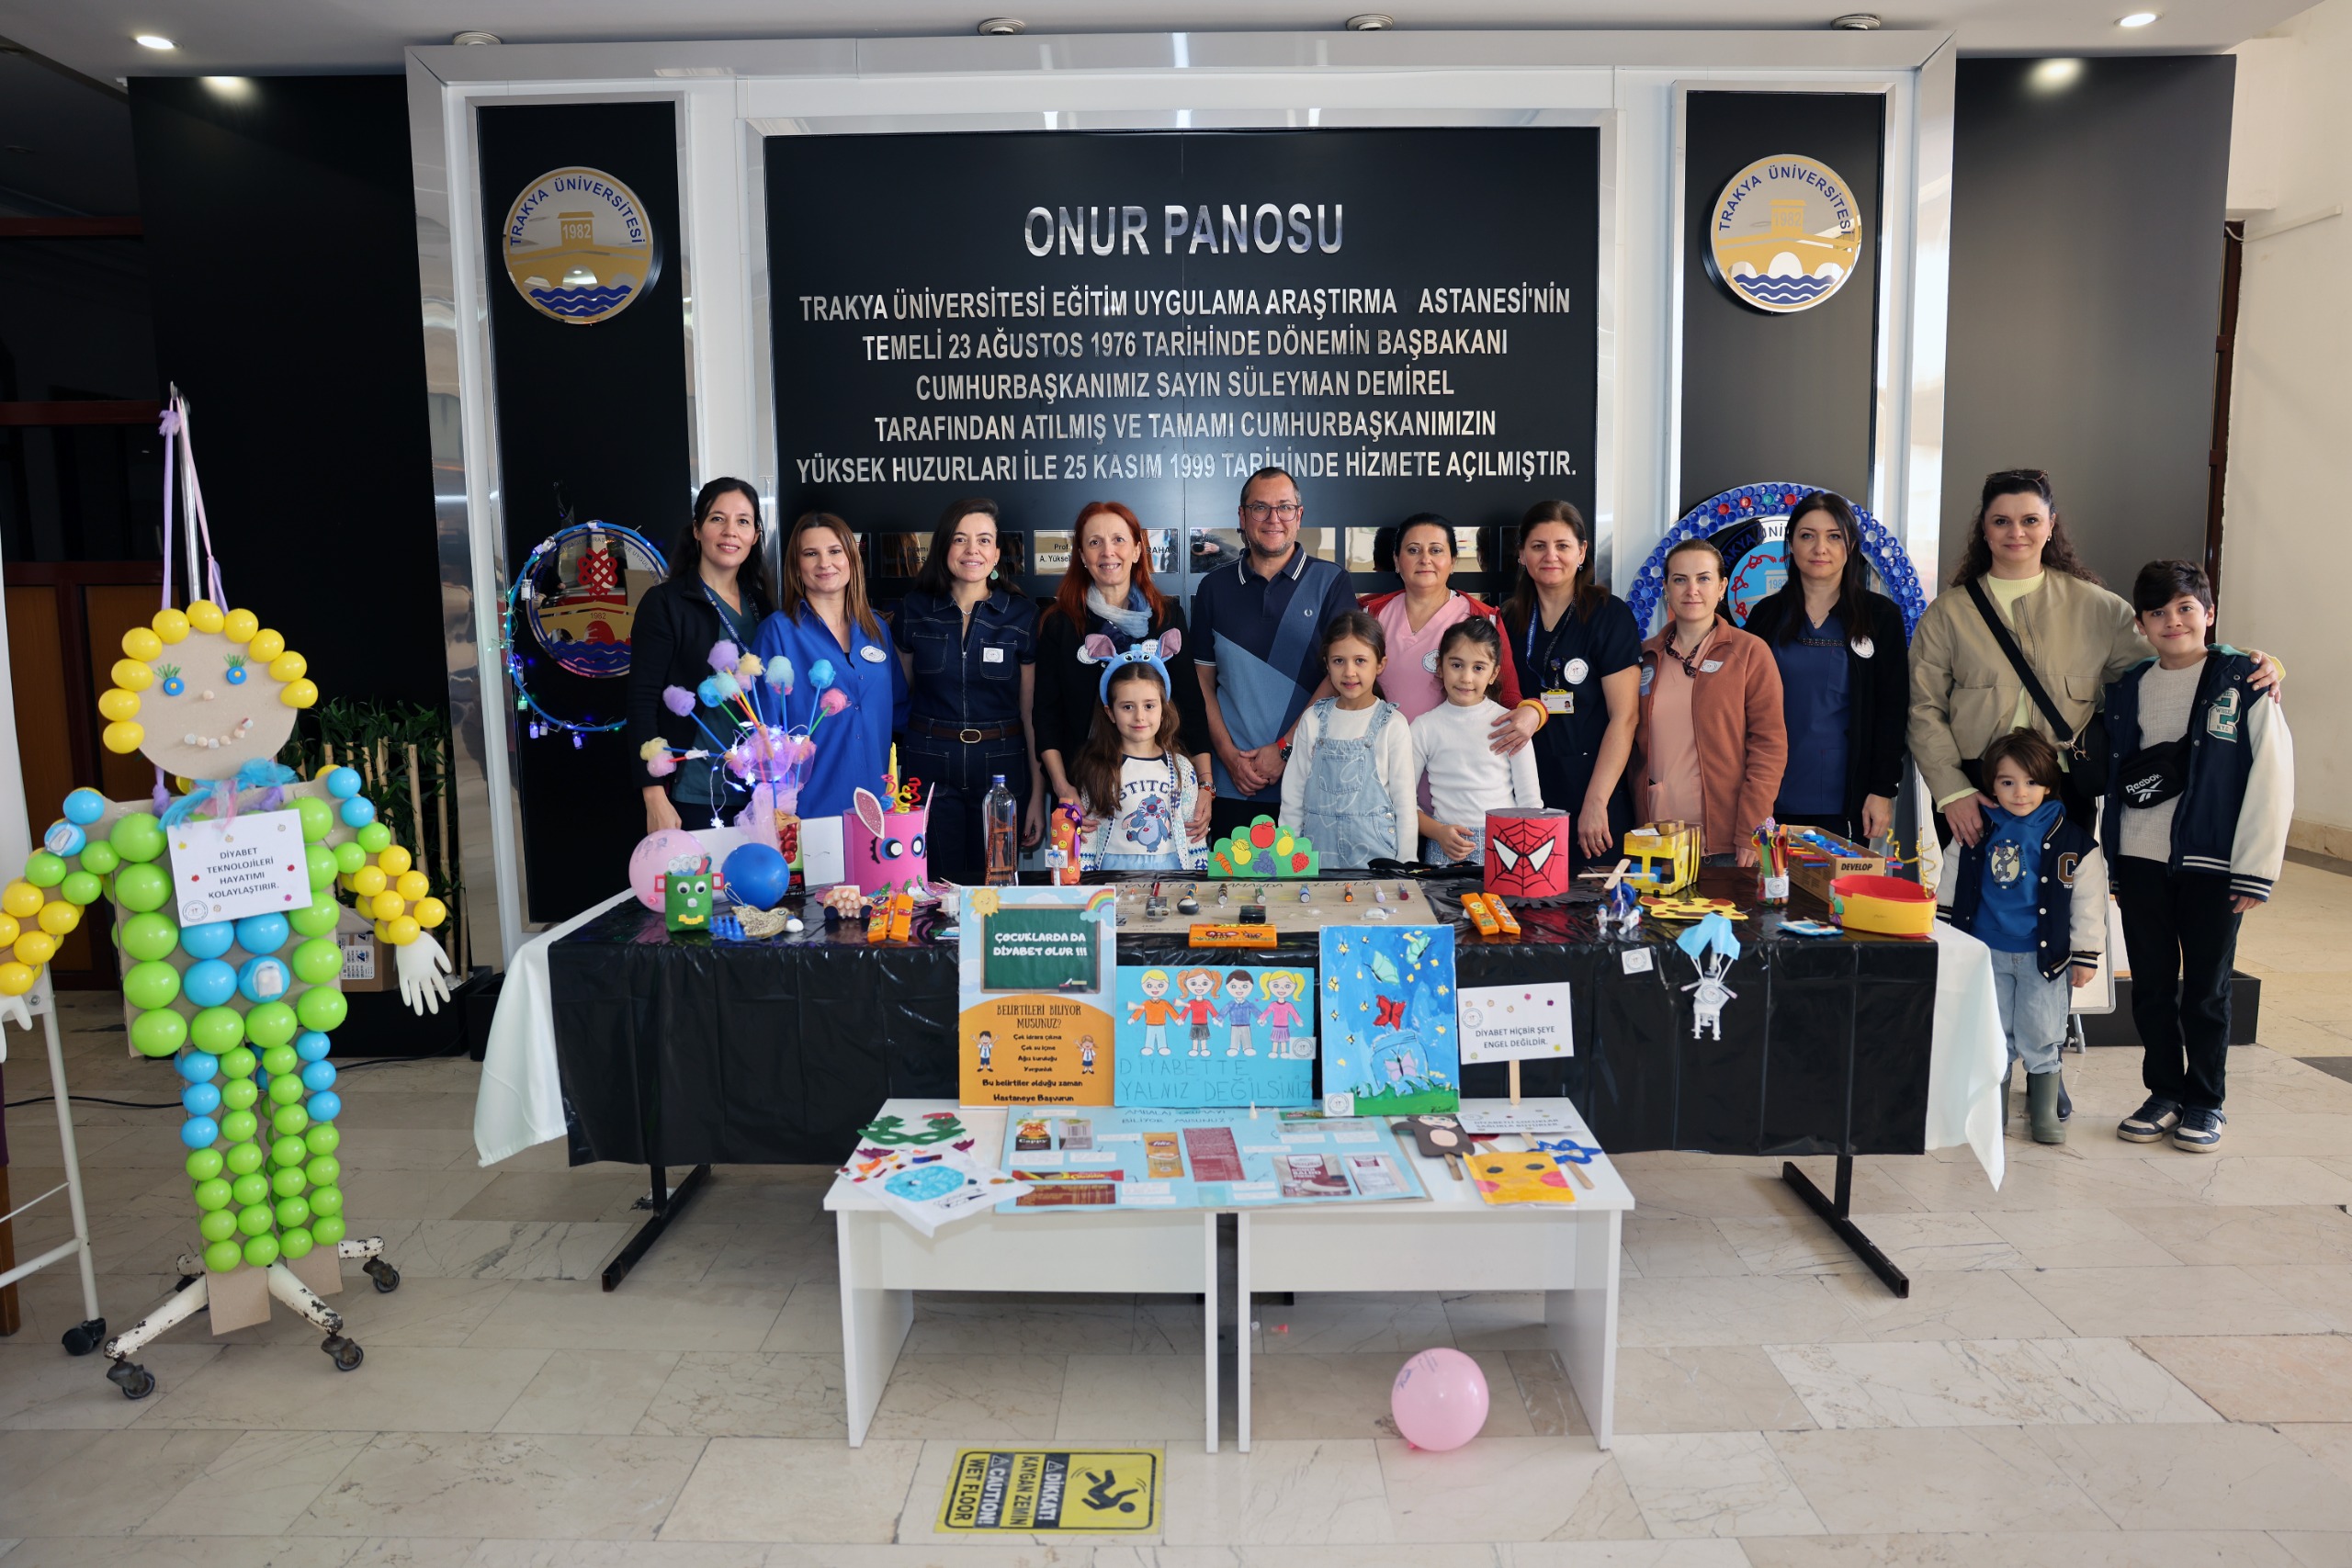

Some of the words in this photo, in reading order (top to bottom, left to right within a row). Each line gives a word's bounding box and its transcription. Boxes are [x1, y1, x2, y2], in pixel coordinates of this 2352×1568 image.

[1719, 175, 1762, 231] TRAKYA
[1769, 164, 1854, 235] ÜNİVERSİTESİ
[510, 188, 549, 246] TRAKYA
[554, 175, 646, 244] ÜNİVERSİTESİ
[1773, 211, 1802, 227] 1982
[562, 223, 592, 240] 1982
[1024, 205, 1150, 257] ONUR
[1164, 202, 1343, 254] PANOSU
[799, 294, 888, 321] TRAKYA
[893, 285, 1046, 321] ÜNİVERSİTESİ
[1052, 285, 1127, 317] EĞİTİM
[1135, 288, 1261, 316] UYGULAMA
[1264, 288, 1398, 321] ARAŞTIRMA
[862, 327, 942, 361] TEMELİ
[948, 333, 971, 359] 23
[976, 324, 1083, 359] AĞUSTOS
[1091, 331, 1136, 357] 1976
[1142, 325, 1261, 357] TARİHİNDE
[1267, 325, 1370, 355] DÖNEMİN
[1377, 328, 1508, 361] BAŞBAKANI
[916, 371, 1150, 405] CUMHURBAŞKANIMIZ
[1156, 371, 1221, 398] SAYIN
[1227, 367, 1350, 398] SÜLEYMAN
[1357, 366, 1455, 396] DEMİREL
[874, 414, 1015, 442] TARAFINDAN
[1021, 412, 1109, 446] ATILMIŞ
[1113, 412, 1143, 439] VE
[1147, 411, 1235, 440] TAMAMI
[1239, 410, 1496, 442] CUMHURBAŞKANIMIZIN
[796, 452, 887, 484] YÜKSEK
[892, 456, 1017, 482] HUZURLARI
[1023, 448, 1057, 480] İLE
[1063, 454, 1088, 480] 25
[1092, 451, 1163, 479] KASIM
[1170, 451, 1216, 479] 1999
[1345, 445, 1441, 477] HİZMETE
[1445, 450, 1577, 483] AÇILMIŞTIR.
[1119, 780, 1170, 801] STITC
[2125, 773, 2163, 794] Reebok
[220, 847, 258, 860] DİYABET
[207, 856, 274, 874] TEKNOLOJİLERİ
[2058, 852, 2078, 884] C
[220, 871, 266, 885] HAYATIMI
[208, 882, 279, 899] KOLAYLAŞTIRIR.
[994, 932, 1068, 943] ÇOCUKLARDA
[1069, 932, 1087, 942] DA
[993, 945, 1044, 956] DİYABET
[1045, 947, 1074, 956] OLUR
[997, 1005, 1045, 1016] BELİRTİLERİ
[1049, 1004, 1081, 1016] BİLİYOR
[1017, 1019, 1062, 1029] MUSUNUZ?
[1476, 1027, 1508, 1037] DİYABET
[1510, 1027, 1535, 1037] HİÇBİR
[1536, 1026, 1555, 1035] ŞEYE
[1484, 1040, 1509, 1049] ENGEL
[1510, 1037, 1548, 1048] DEĞİLDİR.
[1119, 1057, 1250, 1076] DİYABETTE
[996, 1078, 1030, 1087] belirtiler
[1031, 1078, 1057, 1088] olduğu
[1120, 1081, 1189, 1100] YALNIZ
[1204, 1076, 1312, 1101] DEĞİLSİNİZ
[993, 1094, 1035, 1103] Hastaneye
[1037, 1094, 1074, 1103] Başvurun
[965, 1458, 987, 1481] WET
[1017, 1455, 1039, 1493] KAYGAN
[954, 1483, 979, 1521] FLOOR
[977, 1468, 1005, 1526] CAUTION!
[1037, 1472, 1063, 1521] DİKKAT!
[1009, 1494, 1033, 1526] ZEMİN
